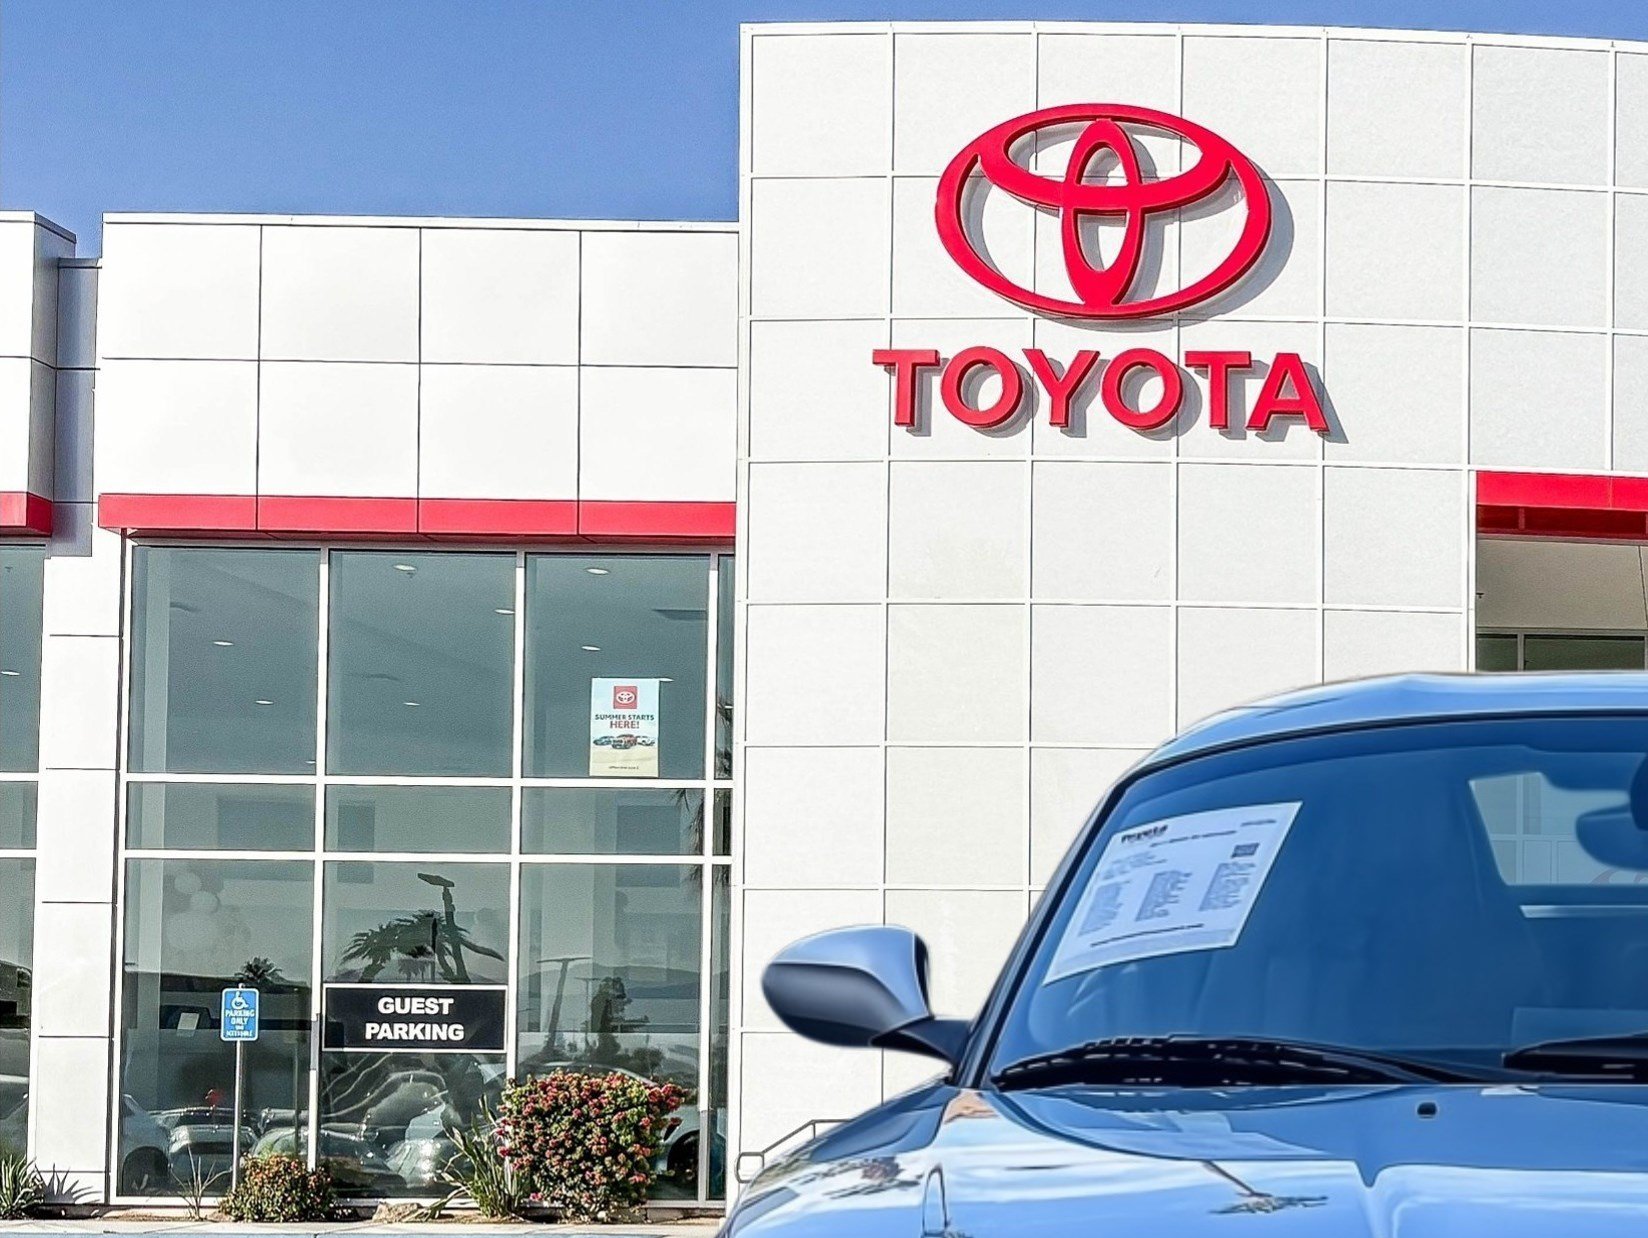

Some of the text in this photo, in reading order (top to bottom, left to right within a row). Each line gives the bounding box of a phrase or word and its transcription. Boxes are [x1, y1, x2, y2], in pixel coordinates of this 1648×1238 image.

[872, 346, 1329, 432] TOYOTA
[610, 721, 640, 729] HERE!
[377, 997, 454, 1015] GUEST
[365, 1023, 464, 1041] PARKING
